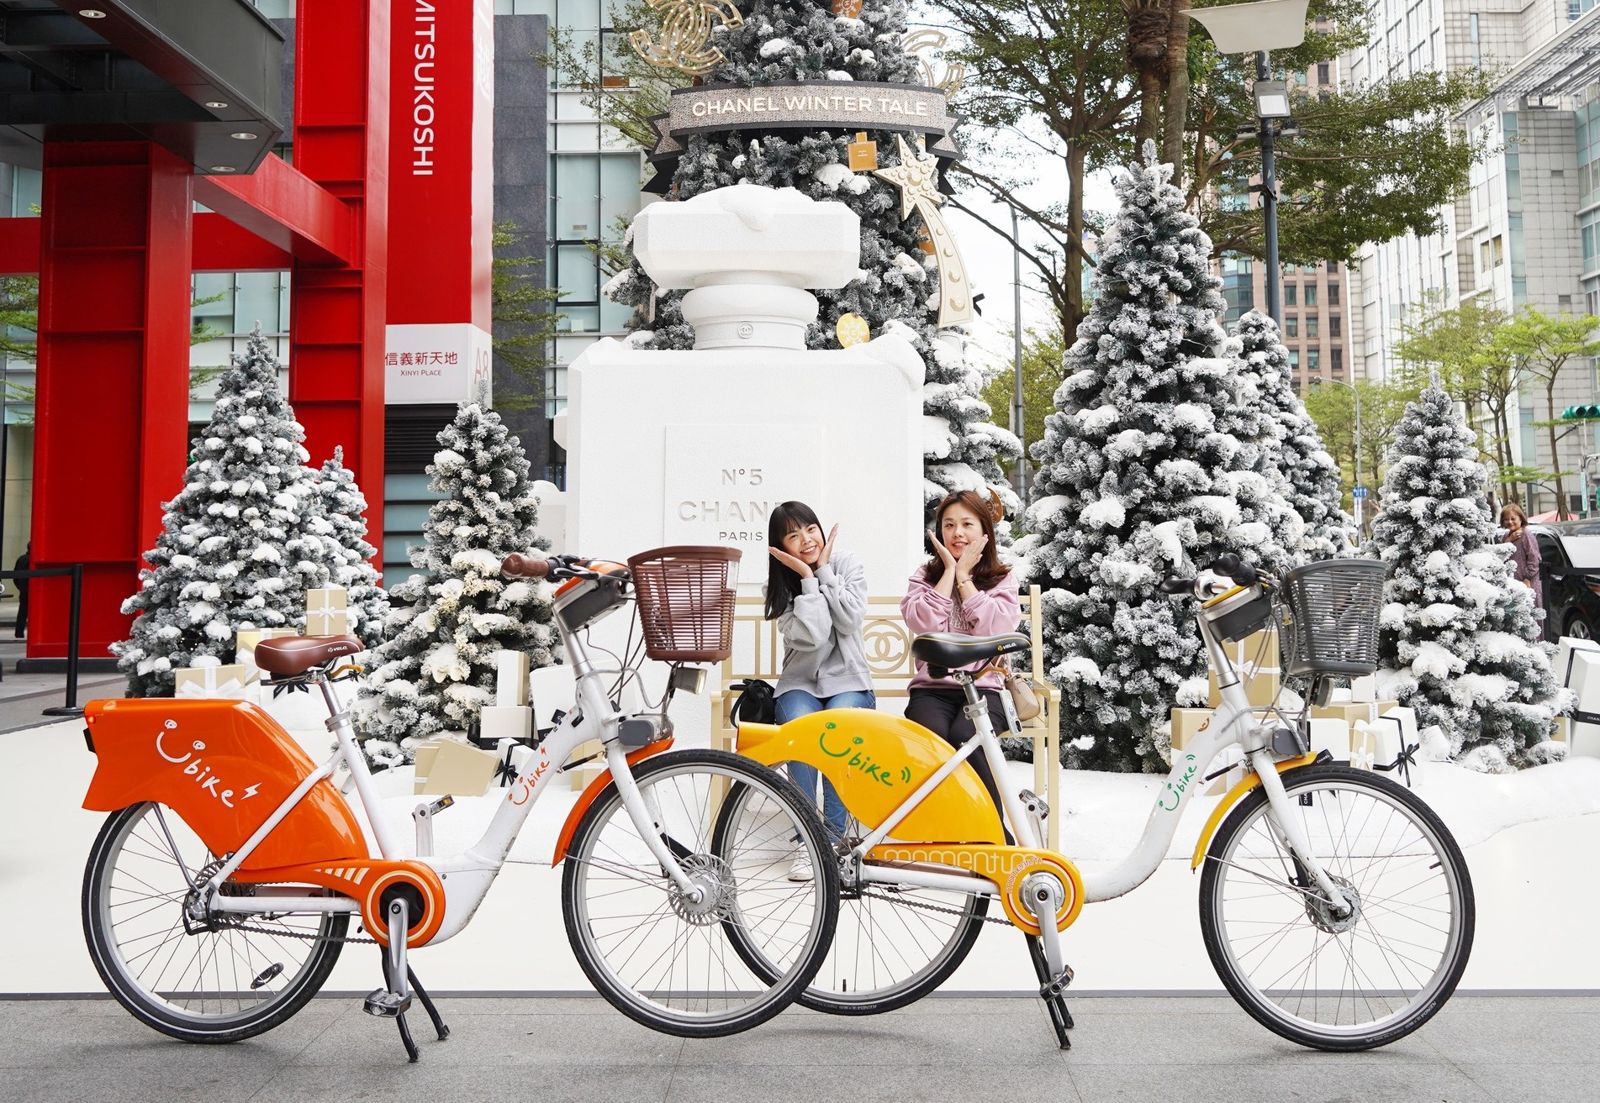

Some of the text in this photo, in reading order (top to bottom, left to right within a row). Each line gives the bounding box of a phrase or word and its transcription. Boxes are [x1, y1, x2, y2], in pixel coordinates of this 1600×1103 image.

[691, 96, 928, 117] CHANEL WINTER TALE
[385, 351, 458, 366] 信義新天地
[679, 500, 783, 522] CHAN
[719, 531, 764, 541] PARIS
[884, 849, 1036, 874] momentum
